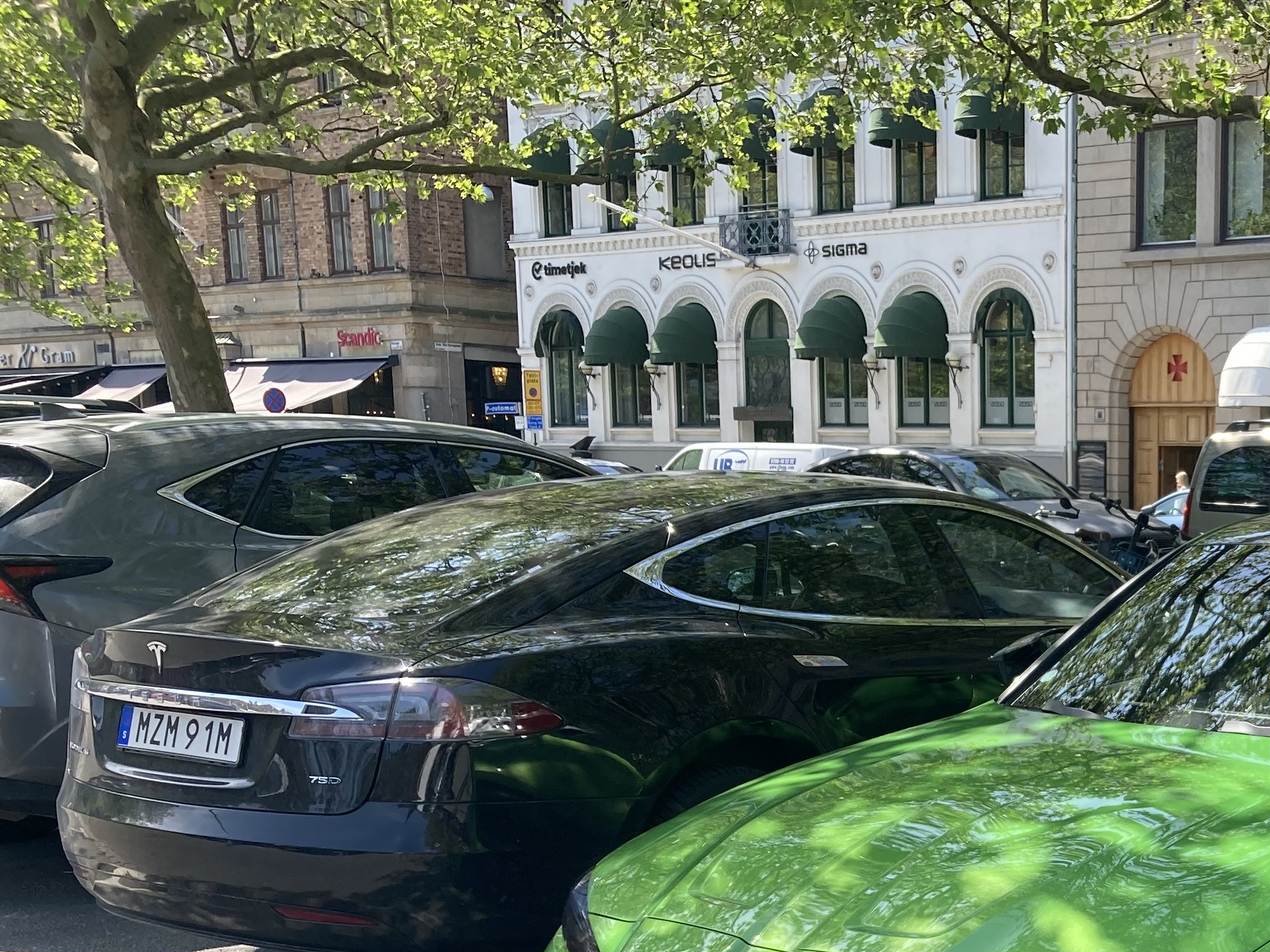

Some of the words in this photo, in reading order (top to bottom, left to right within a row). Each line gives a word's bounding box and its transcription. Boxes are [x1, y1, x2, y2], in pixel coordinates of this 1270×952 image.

[543, 260, 588, 279] timetjek
[336, 327, 382, 347] Scandic
[41, 347, 75, 364] Gram
[135, 711, 180, 748] MZM
[185, 718, 233, 755] 91M
[308, 775, 342, 785] 75D
